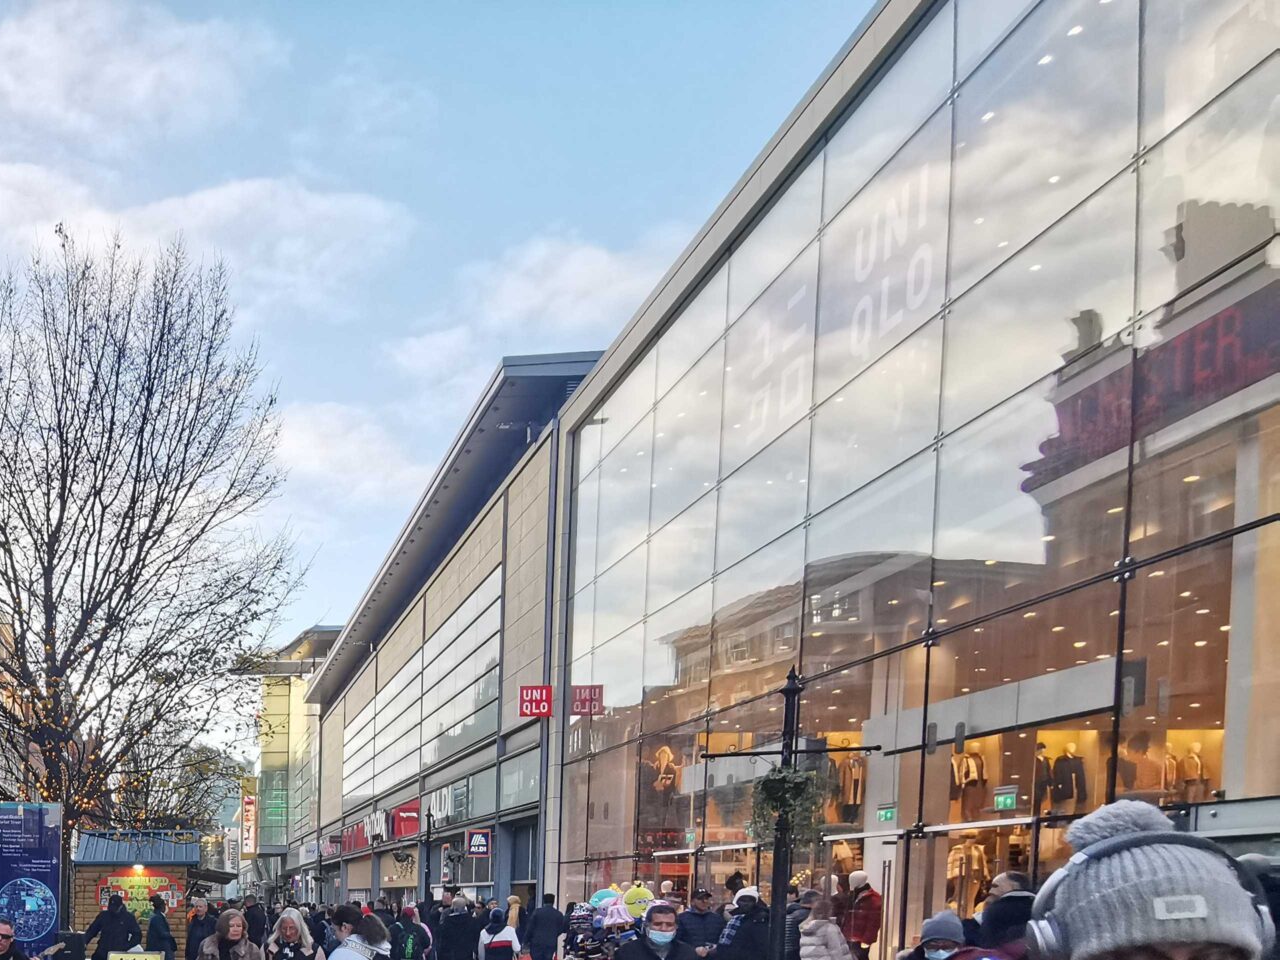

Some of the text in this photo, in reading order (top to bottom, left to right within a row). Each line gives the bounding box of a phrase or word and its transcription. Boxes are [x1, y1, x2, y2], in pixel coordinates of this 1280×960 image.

[854, 163, 929, 283] UNI
[850, 242, 933, 360] QLO
[523, 689, 546, 700] UNI
[523, 701, 548, 715] QLO
[430, 784, 455, 824] ALDI
